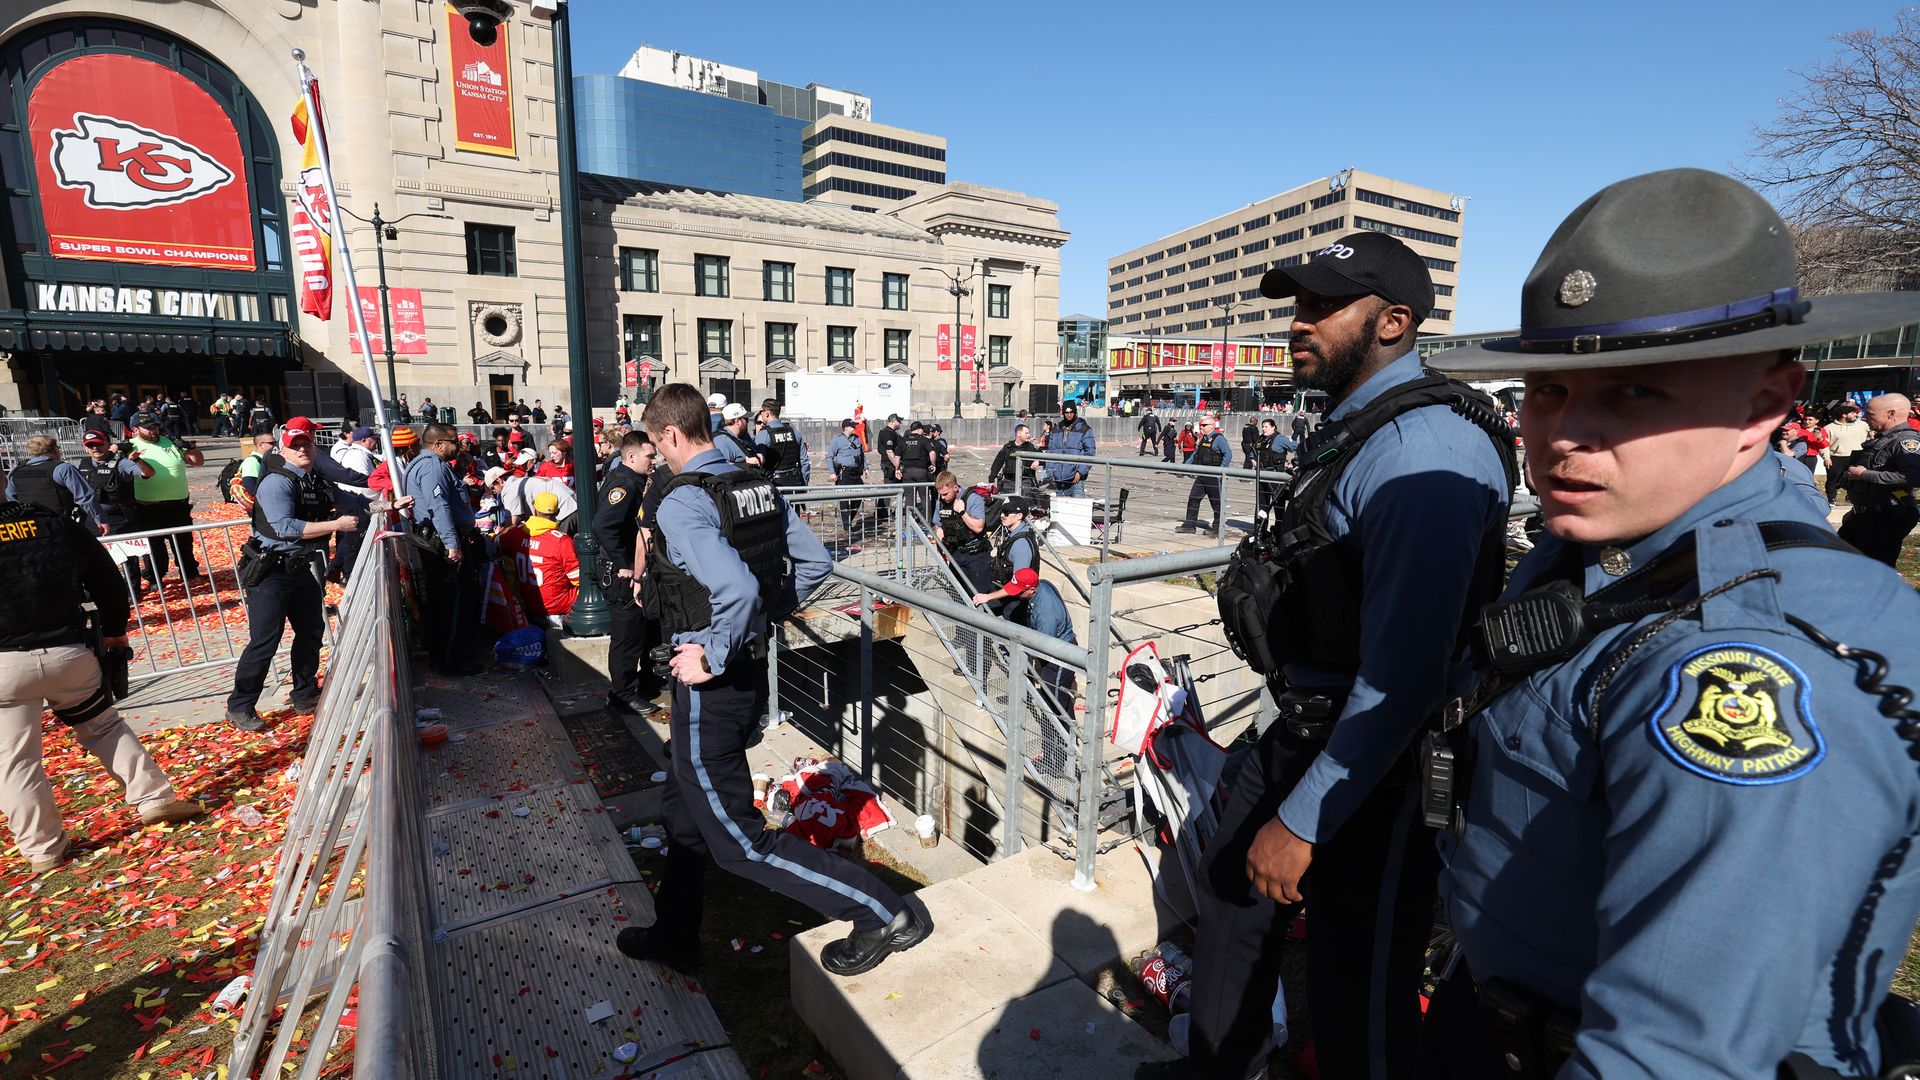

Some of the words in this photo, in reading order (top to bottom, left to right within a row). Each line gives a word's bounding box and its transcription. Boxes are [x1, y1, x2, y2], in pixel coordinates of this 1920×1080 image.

[456, 80, 479, 90] UNION
[480, 85, 507, 96] STATION
[461, 89, 486, 99] KANSAS
[487, 93, 503, 102] CITY
[94, 137, 193, 192] KC
[1361, 220, 1386, 233] BLUE
[1391, 226, 1405, 236] KC
[60, 242, 111, 254] SUPER
[115, 246, 160, 257] BOWL
[164, 249, 249, 262] CHAMPIONS
[1316, 243, 1354, 259] CPD
[38, 284, 152, 314] KANSAS
[163, 291, 219, 318] CITY
[1110, 343, 1161, 368] BACK
[1177, 345, 1196, 364] TO
[774, 432, 793, 443] POLICE
[732, 485, 776, 518] POLICE
[516, 552, 543, 588] 05
[1503, 609, 1514, 642] MOTOROLA
[1684, 652, 1750, 678] MISSOURI
[1752, 656, 1794, 687] STATE
[1666, 725, 1735, 771] HIGHWAY
[1742, 744, 1811, 773] PATROL
